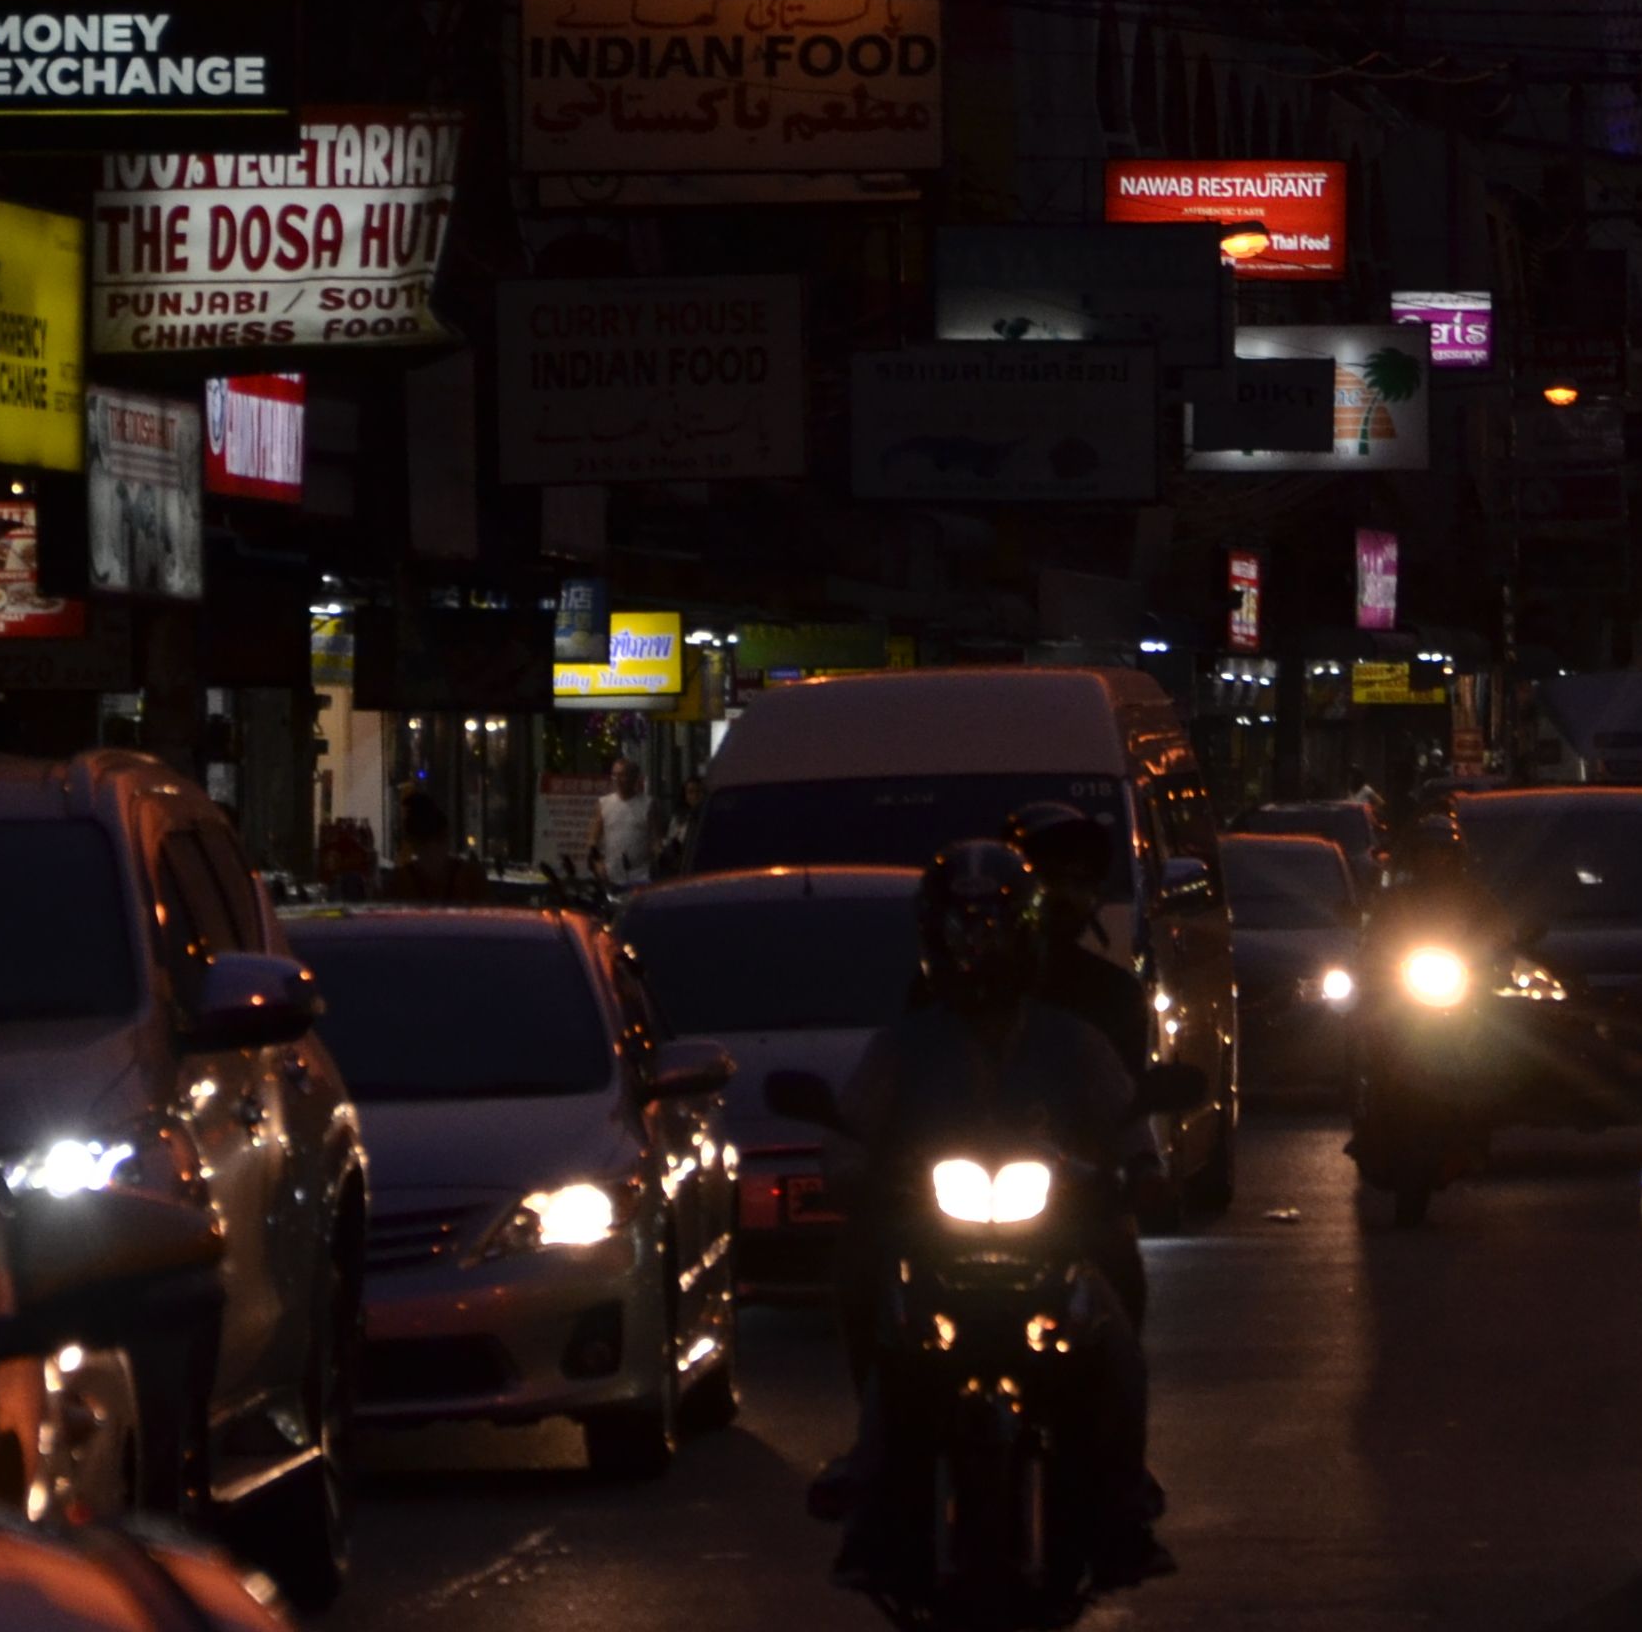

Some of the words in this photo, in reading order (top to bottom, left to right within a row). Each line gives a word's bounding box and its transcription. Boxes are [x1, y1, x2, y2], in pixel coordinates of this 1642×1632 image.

[530, 36, 743, 79] INDIAN
[765, 34, 936, 77] FOOD
[1120, 175, 1194, 197] NAWAB
[1198, 176, 1326, 198] RESTAURANT
[97, 204, 191, 274] THE
[210, 202, 343, 271] DOSA
[360, 199, 455, 270] HUT
[1271, 233, 1297, 251] Thai
[1300, 233, 1331, 251] Food
[107, 290, 268, 318] PUNJABI
[530, 303, 643, 338] CURRY
[655, 299, 769, 337] HOUSE
[131, 321, 296, 350] CHINESS
[322, 317, 421, 341] FOOD
[531, 349, 656, 389] INDIAN
[669, 346, 768, 385] FOOD
[1070, 781, 1114, 799] 018
